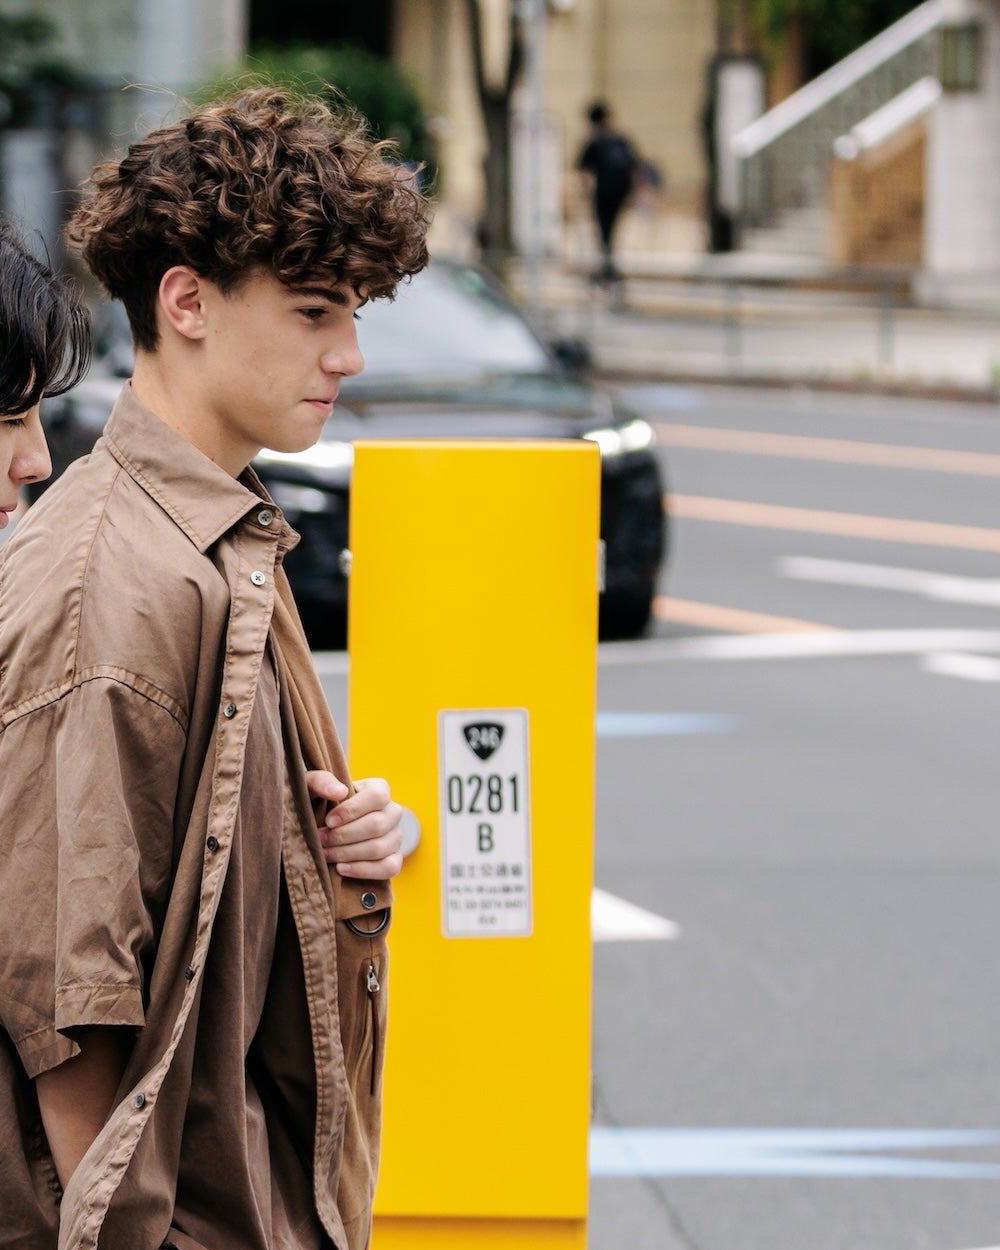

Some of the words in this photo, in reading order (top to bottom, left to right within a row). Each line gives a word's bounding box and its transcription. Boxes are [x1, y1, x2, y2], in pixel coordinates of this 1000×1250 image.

[467, 726, 501, 750] 246
[448, 773, 518, 814] 0281
[478, 822, 494, 852] B
